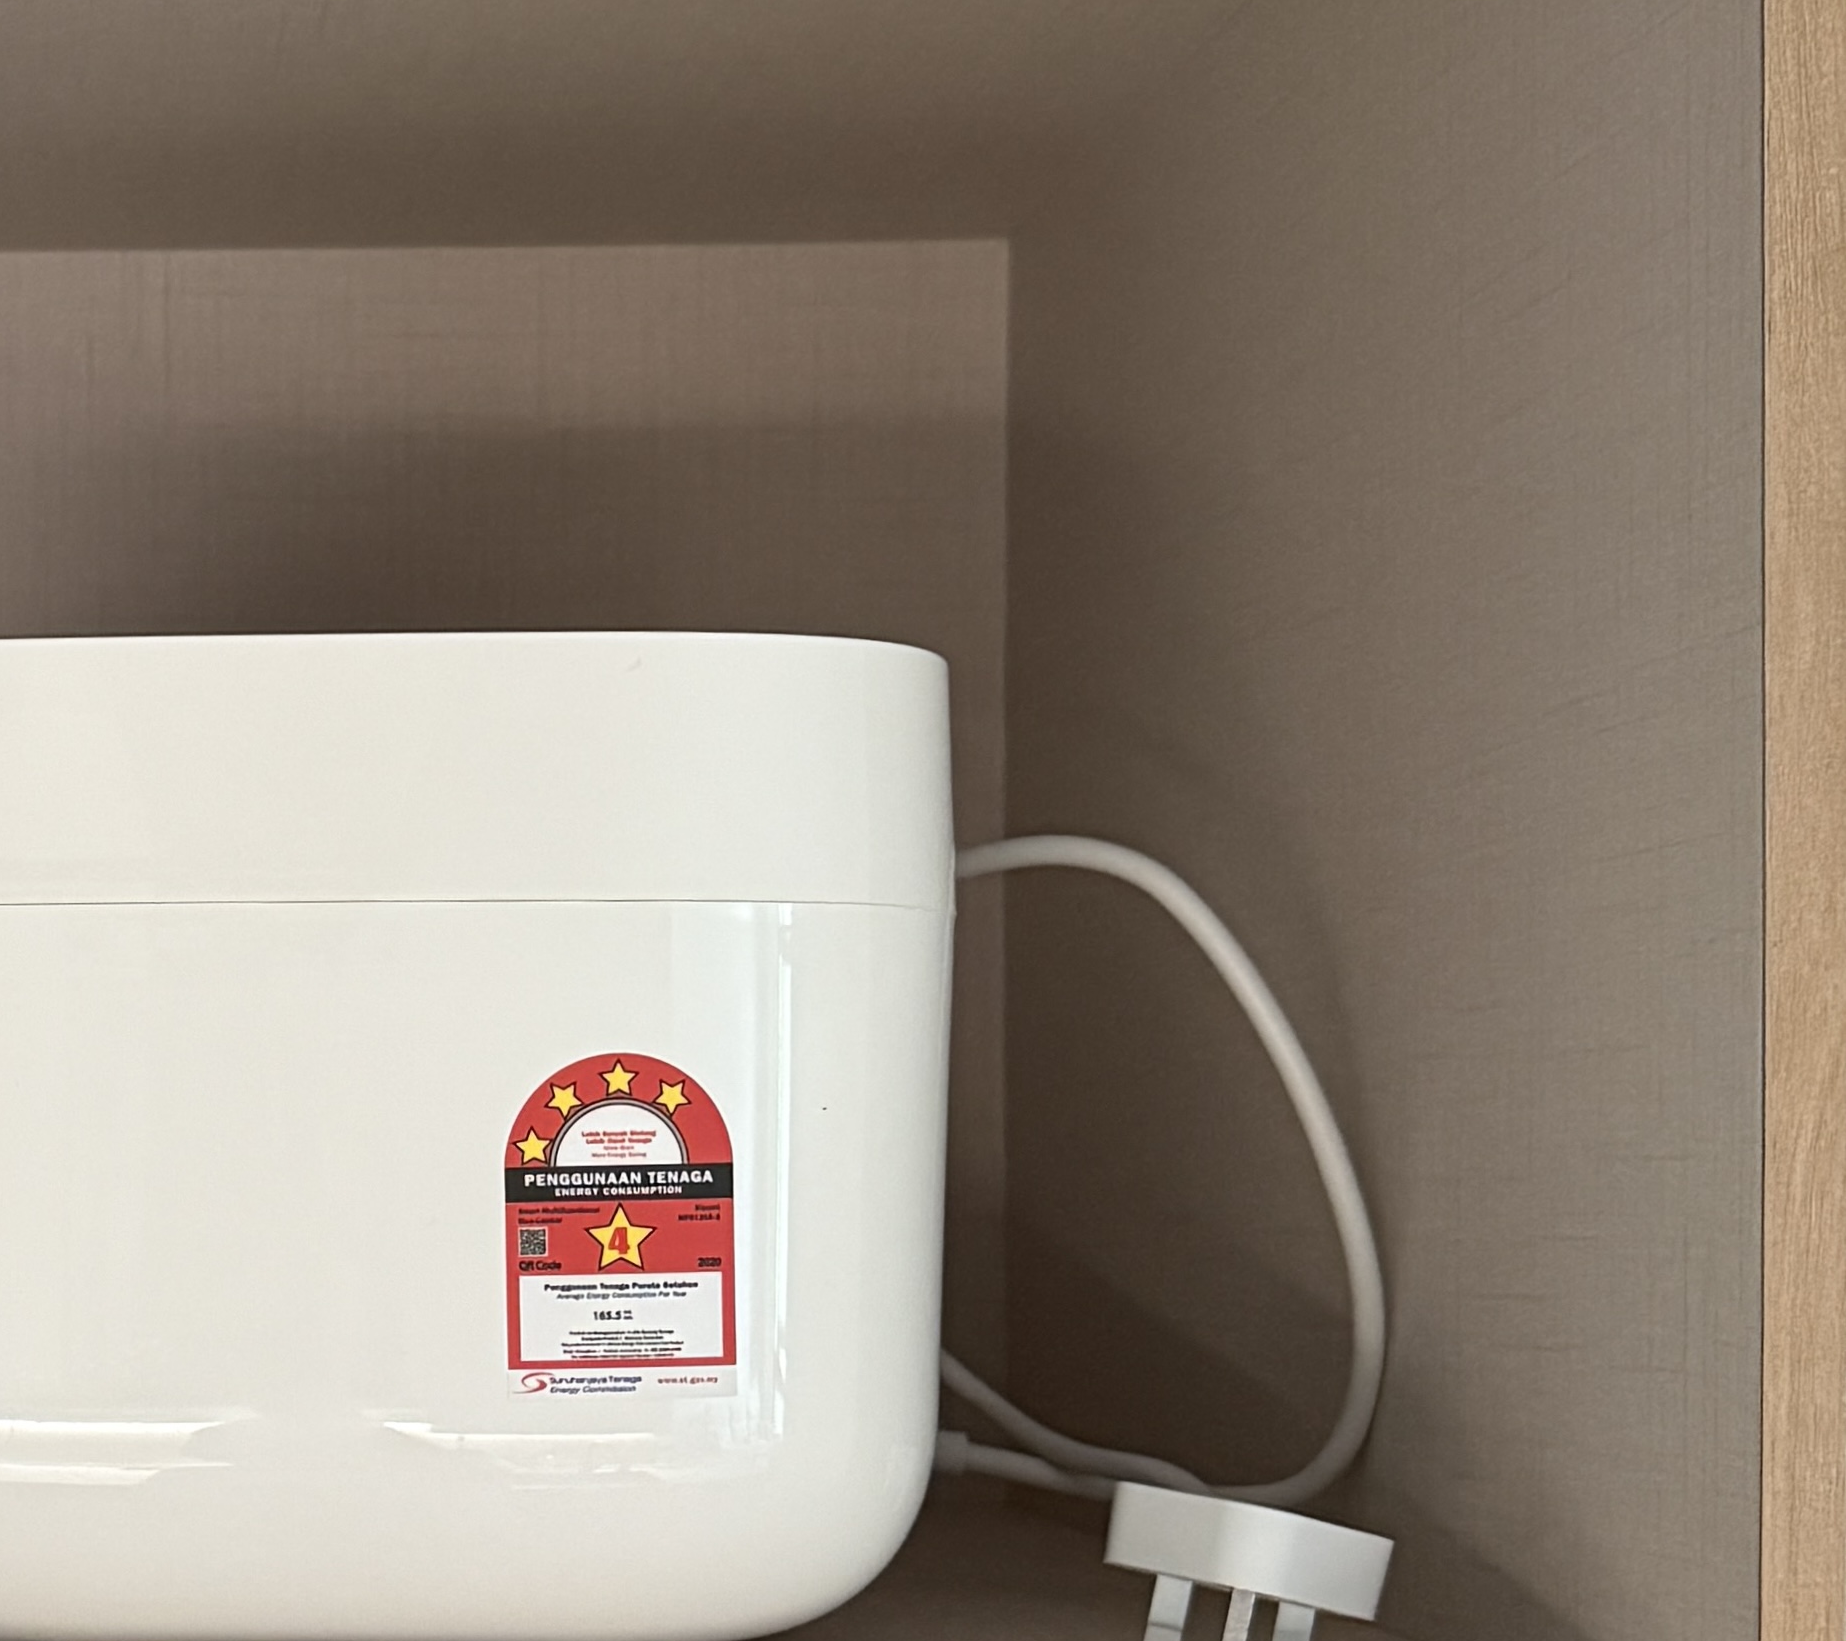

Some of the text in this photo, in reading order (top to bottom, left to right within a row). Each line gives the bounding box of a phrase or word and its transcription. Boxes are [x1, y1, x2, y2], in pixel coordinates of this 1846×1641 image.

[524, 1170, 714, 1187] PENGGUNAAN TENAGA
[555, 1185, 683, 1197] ENERGY CONSUMPTION
[608, 1227, 630, 1255] 4
